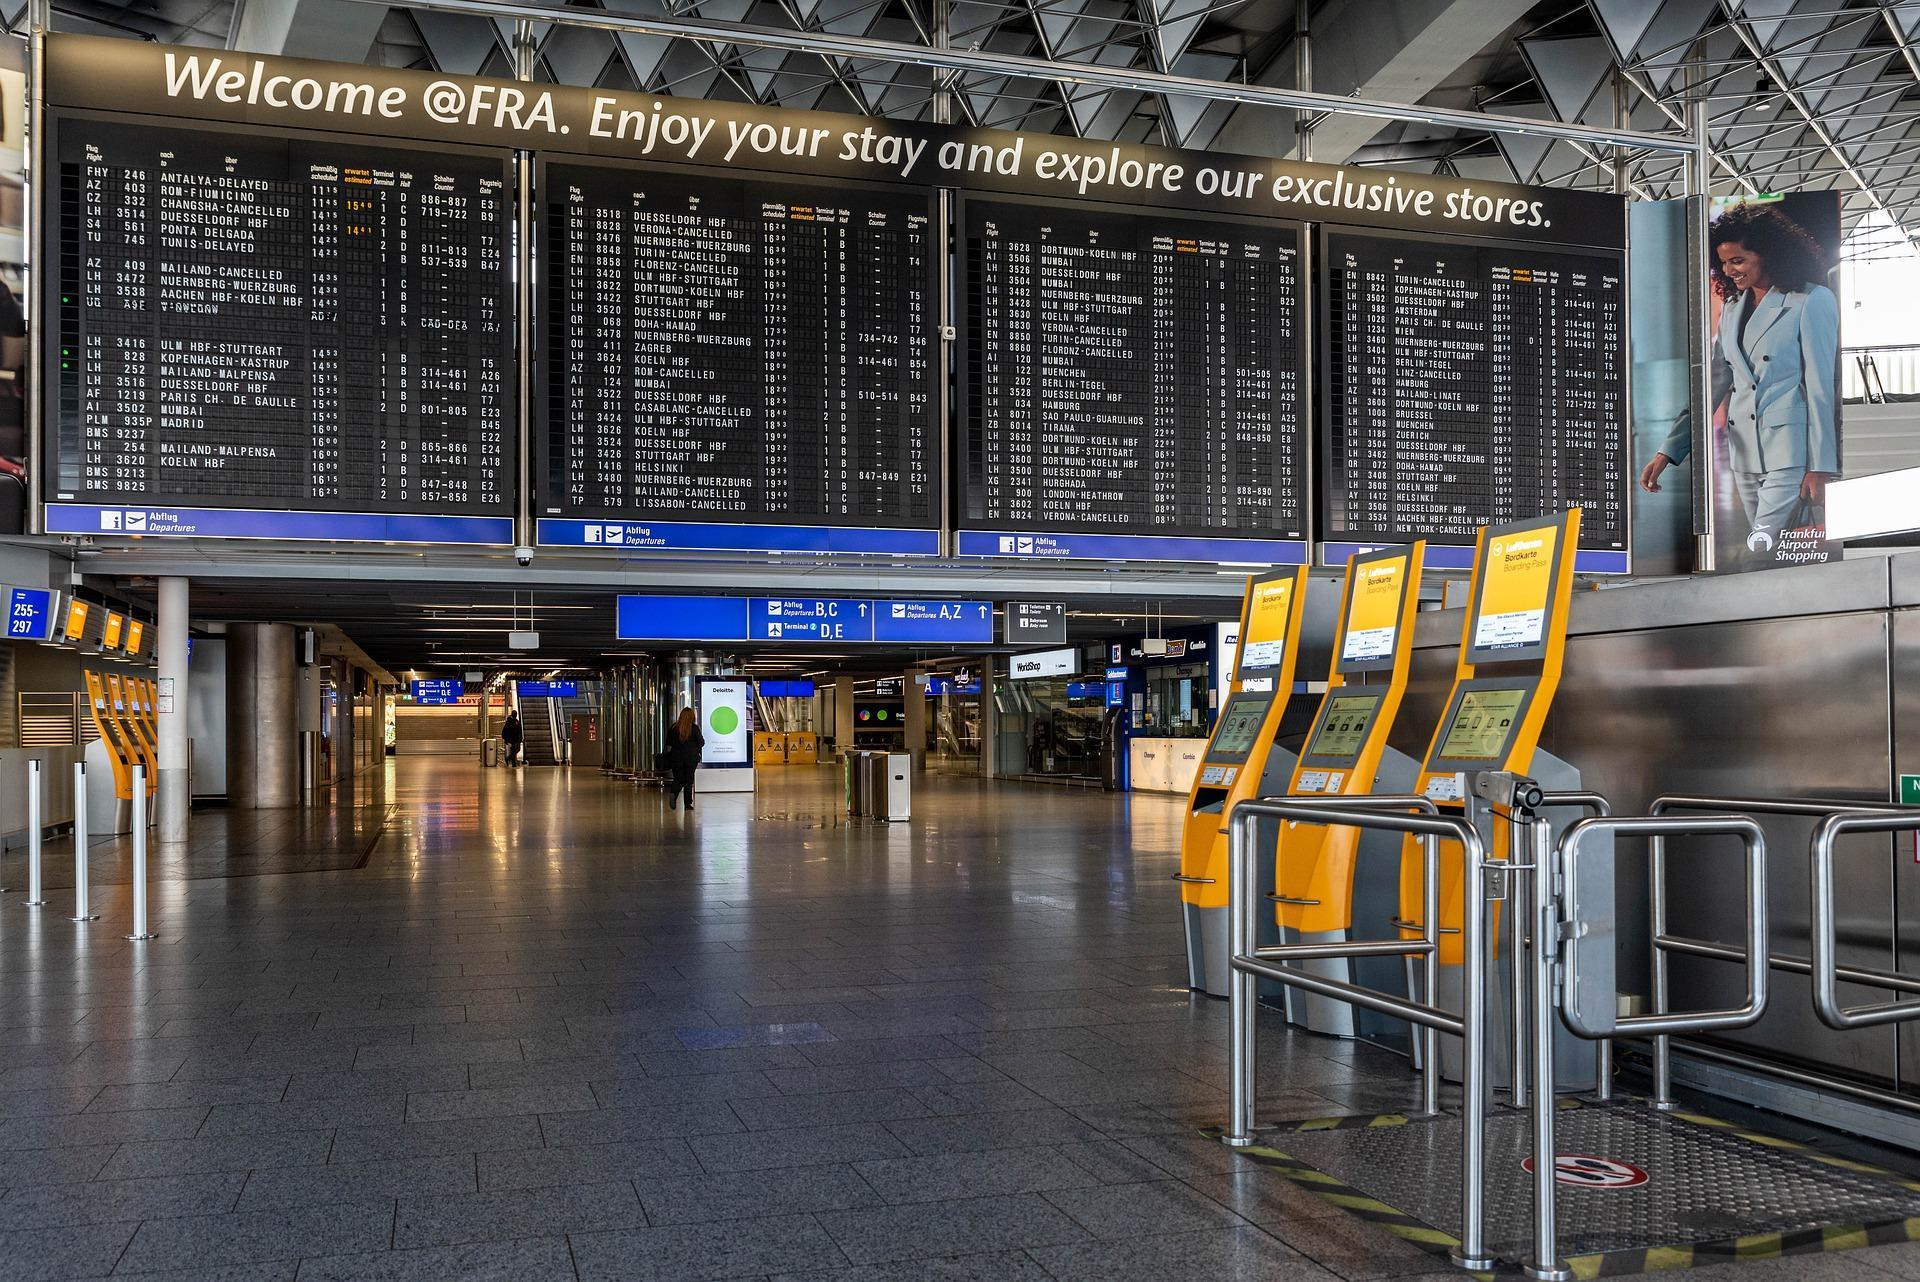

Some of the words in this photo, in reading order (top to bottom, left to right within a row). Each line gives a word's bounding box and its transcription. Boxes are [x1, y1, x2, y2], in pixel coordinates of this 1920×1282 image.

[164, 53, 407, 118] Welcome
[423, 80, 571, 136] @FRA.
[590, 96, 714, 158] Enjoy
[724, 122, 829, 162] your
[839, 127, 927, 177] stay
[938, 137, 1024, 176] and
[1034, 147, 1184, 195] explore
[1195, 166, 1264, 199] our
[1272, 170, 1434, 216] exclusive
[1443, 187, 1552, 228] stores.
[86, 144, 98, 153] Flug
[86, 153, 103, 162] Flight
[225, 156, 238, 164] über
[311, 172, 338, 182] scheduled
[344, 176, 372, 184] estimated
[373, 170, 394, 178] Terminal
[400, 172, 412, 180] Halle
[434, 174, 454, 183] Schalter
[87, 166, 108, 177] FHY
[124, 170, 145, 180] 246
[160, 172, 268, 190] ANTALYA-DELAYED
[421, 194, 466, 207] 886-887
[481, 200, 493, 209] E3
[374, 178, 395, 186] Terminal
[400, 180, 410, 188] Hall
[434, 184, 454, 192] Counter
[480, 179, 502, 188] Flugsteig
[161, 185, 254, 202] ROM-FIUMICINO
[161, 198, 289, 218] CHANGSHA-CANCELLED
[161, 211, 240, 226] DUESSELDORF
[248, 218, 268, 228] HBF
[571, 206, 583, 216] LH
[596, 208, 620, 219] 3518
[634, 212, 701, 225] DUESSELDORF
[708, 218, 726, 228] HBF
[161, 224, 197, 236] PONTA
[204, 227, 254, 240] DELGADA
[634, 224, 732, 240] VERONA-CANCELLED
[161, 237, 254, 253] TUNIS-DELAYED
[634, 247, 726, 262] TURIN-CANCELLED
[161, 262, 282, 280] MAILAND-CANCELLED
[634, 259, 738, 275] FLORENZ-CANCELLED
[986, 252, 996, 260] AI
[1008, 254, 1030, 263] 3506
[1042, 256, 1072, 266] MUMBAI
[1280, 276, 1294, 285] B28
[634, 271, 652, 280] ULM
[659, 273, 738, 287] HBF-STUTTGART
[1347, 271, 1356, 279] EN
[1366, 272, 1385, 282] 8842
[1395, 275, 1465, 288] TURIN-CANCELLED
[1394, 286, 1478, 300] KOPENHAGEN-KASTRUP
[634, 294, 690, 307] STUTTGART
[696, 299, 714, 308] HBF
[1394, 306, 1437, 316] AMSTERDAM
[603, 316, 621, 326] 068
[634, 318, 696, 331] DOHA-HAMAD
[1042, 322, 1127, 336] VERONA-CANCELLED
[1395, 327, 1414, 336] WIEN
[634, 342, 672, 353] ZAGREB
[1042, 345, 1132, 359] FLORDNZ-CANCELLED
[161, 353, 289, 369] KOPENHAGEN-KASTRUP
[634, 366, 714, 380] ROM-CANCELLED
[1042, 367, 1086, 378] MUENCHEN
[1396, 368, 1461, 380] LINZ-CANCELLED
[1042, 378, 1106, 390] BERLIN-TEGEL
[161, 392, 196, 403] PARIS
[205, 394, 224, 404] CH.
[234, 395, 246, 405] DE
[255, 396, 296, 408] GAULLE
[1396, 389, 1461, 401] MAILAND-LINATE
[634, 402, 751, 417] CASABLANC-CANCELLED
[1042, 400, 1080, 411] HAMBURG
[1042, 412, 1058, 420] SAO
[1064, 412, 1144, 425] PAULO-GUARULHOS
[1396, 410, 1433, 420] BRUESSEL
[161, 418, 204, 428] MADRID
[1043, 422, 1075, 432] TIRANA
[1396, 430, 1429, 440] ZUERICH
[635, 462, 683, 472] HELSINKI
[859, 471, 898, 481] 847-849
[911, 473, 926, 482] E21
[1372, 460, 1386, 469] 072
[1396, 462, 1443, 472] DOHA-HAMAD
[1043, 478, 1086, 488] HURGHADA
[1043, 490, 1123, 500] LONDON-HEATHROW
[1396, 493, 1433, 502] HELSINKI
[636, 498, 746, 510] LISSABON-CANCELLED
[1043, 500, 1070, 510] KOELN
[1076, 502, 1091, 510] HBF
[150, 512, 178, 524] Abflug
[150, 522, 196, 534] Departures
[626, 526, 651, 537] Abflug
[1396, 524, 1411, 532] NEW
[1416, 525, 1480, 537] YORK-CANCELLE
[626, 535, 666, 546] Departures
[1035, 537, 1057, 547] Abflug
[1778, 539, 1818, 552] Airport
[1035, 546, 1070, 556] Departures
[1505, 551, 1538, 562] Bordkarte
[1776, 550, 1828, 563] Shopping
[1368, 576, 1392, 586] Bordkarte
[14, 604, 39, 617] 255-
[784, 602, 802, 610] Abflug
[816, 602, 838, 618] B,C
[908, 604, 926, 612] Abflug
[940, 604, 962, 620] A,Z
[784, 608, 814, 617] Departures
[907, 612, 936, 620] Departures
[12, 620, 32, 633] 297
[820, 624, 843, 639] D,E
[1017, 662, 1040, 672] WorldShop
[1176, 666, 1192, 676] Change
[1144, 752, 1155, 760] Change
